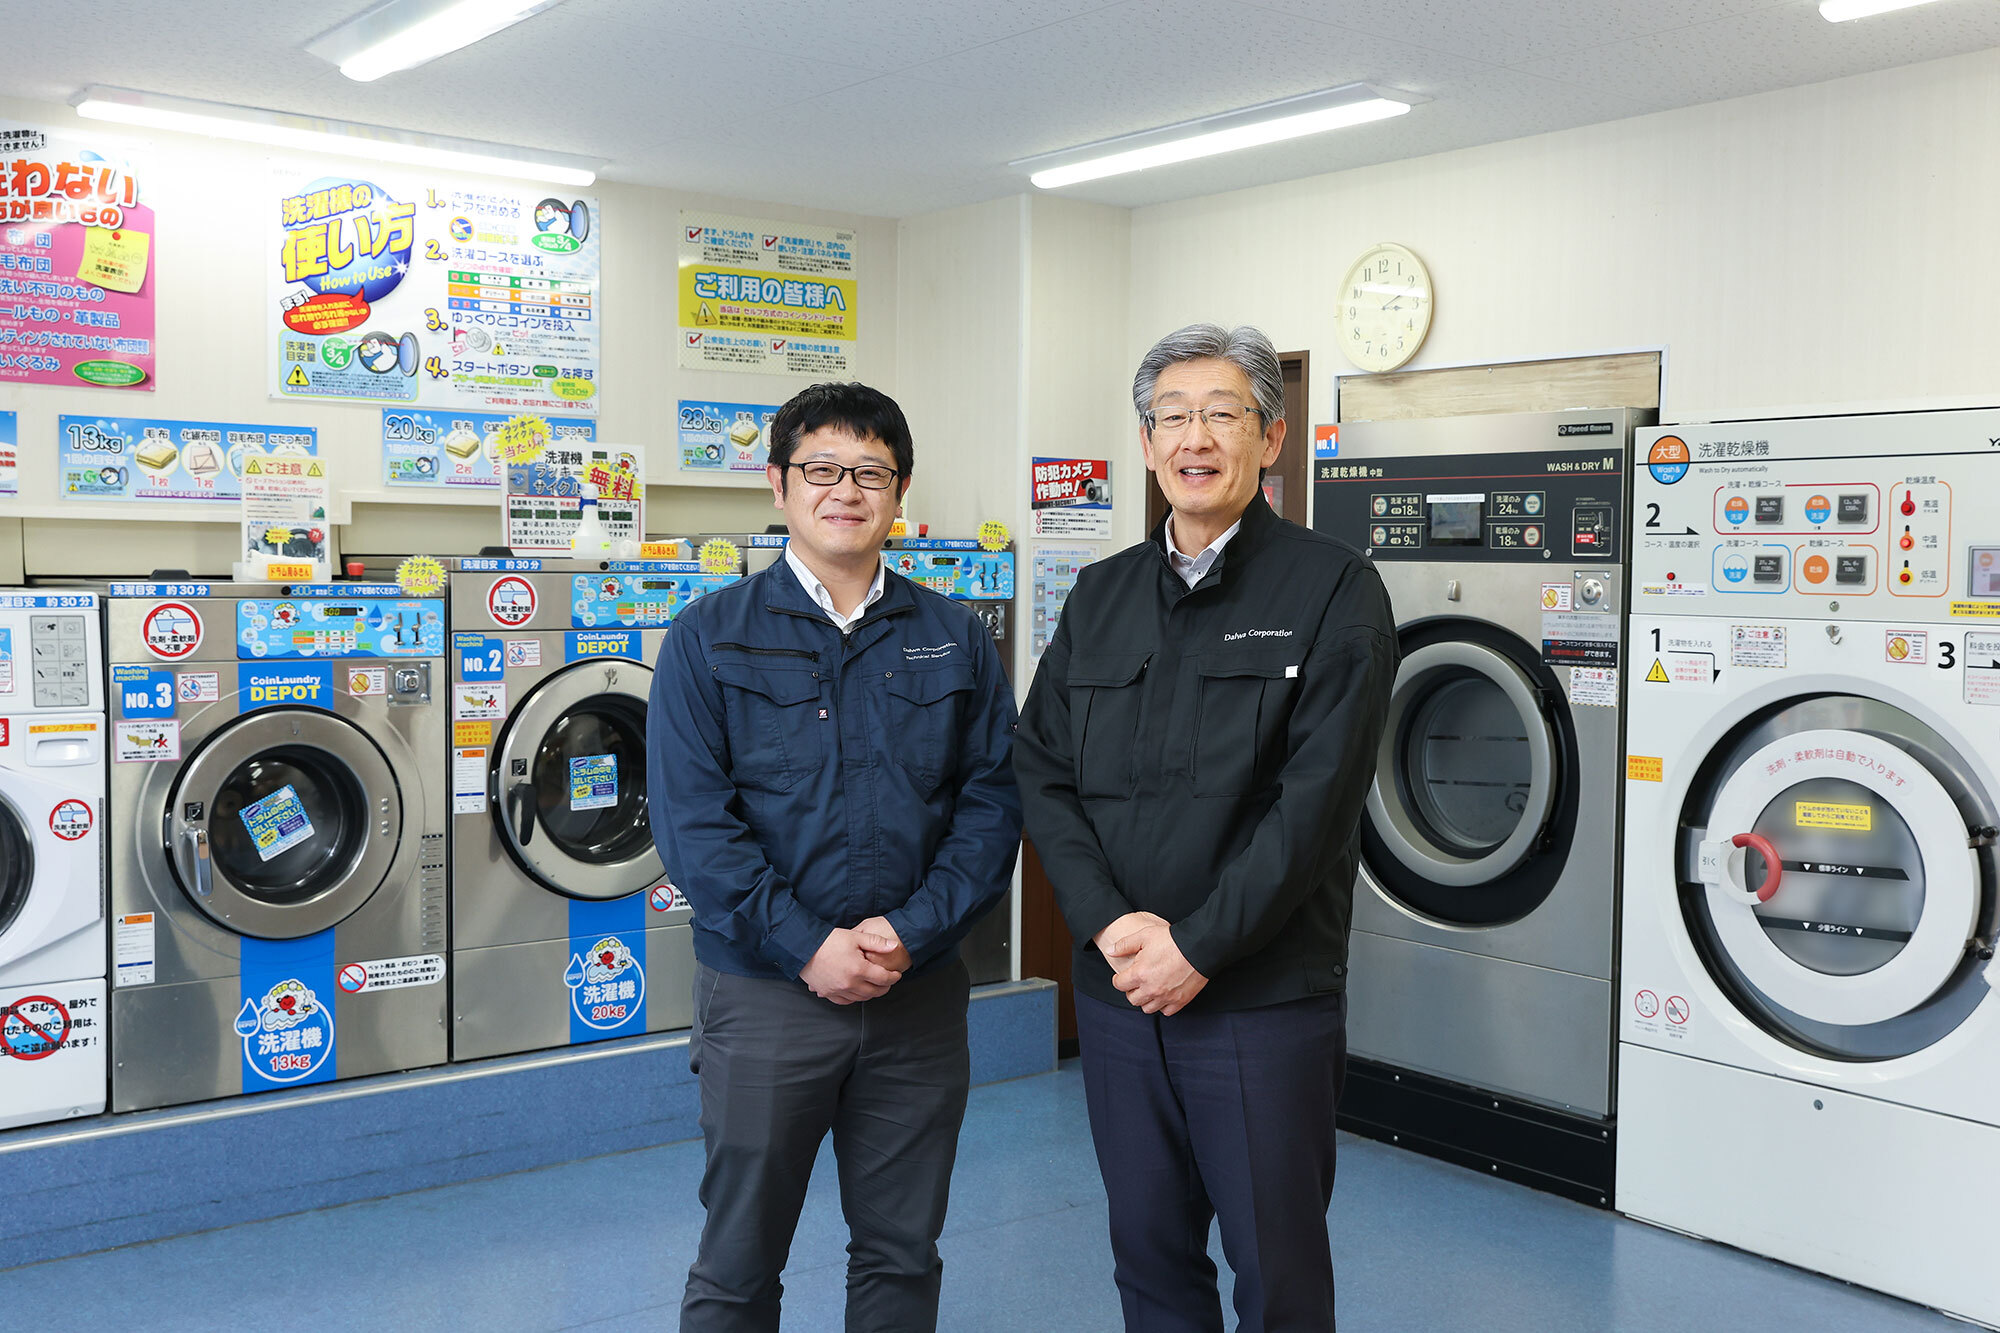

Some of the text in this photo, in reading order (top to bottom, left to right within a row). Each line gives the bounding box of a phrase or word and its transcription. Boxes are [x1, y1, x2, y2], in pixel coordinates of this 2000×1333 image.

[0, 159, 134, 204] わない
[427, 188, 446, 207] 1.
[282, 184, 372, 226] 洗濯機の
[281, 202, 415, 283] 使い方
[704, 237, 752, 248] ご確認ください
[425, 239, 544, 266] 2. 洗濯コースを選ぶ
[1378, 258, 1389, 274] 12
[1397, 261, 1401, 276] 1
[320, 265, 392, 291] How to Use
[1364, 268, 1372, 282] 11
[1407, 275, 1416, 288] 2
[695, 272, 846, 311] ご利用の皆様へ
[1353, 286, 1362, 299] 10
[280, 290, 310, 311] まず!
[1411, 296, 1420, 310] 3
[720, 306, 741, 314] 当店は
[1349, 306, 1357, 320] 9
[425, 308, 575, 332] 3. ゆっくりとコインを投入
[1406, 317, 1413, 331] 4
[1353, 327, 1361, 341] 8
[286, 341, 316, 352] 洗濯物
[1365, 340, 1372, 354] 7
[1396, 336, 1404, 350] 5
[1380, 344, 1388, 357] 6
[425, 356, 594, 380] 4. スタートボタン を押す
[453, 420, 473, 430] 毛布
[504, 419, 535, 434] ラッキー
[681, 407, 722, 434] 28kg
[145, 429, 169, 439] 毛布
[386, 416, 435, 444] 20kg
[505, 428, 536, 443] サイクル
[67, 424, 124, 454] 13kg
[1316, 433, 1336, 450] NO.1
[504, 438, 535, 459] 当たり
[1656, 440, 1769, 460] 大型 洗濯乾燥機
[545, 450, 583, 465] 洗濯機
[738, 451, 753, 461] 4枚
[265, 462, 302, 475] ご注意
[455, 464, 473, 475] 2枚
[535, 464, 584, 478] ラッキー
[1547, 457, 1614, 472] WASH & DRY M
[1720, 466, 1730, 475] Dry
[1731, 465, 1768, 473] automatically
[1034, 462, 1093, 483] 防犯カメラ
[1321, 466, 1383, 479] 洗濯乾燥機 中型
[1662, 473, 1674, 482] Dry
[148, 475, 214, 488] 1枚 1枚
[589, 466, 634, 502] 無料
[1905, 476, 1936, 485] 乾燥温度
[533, 481, 580, 495] サイクル
[1036, 479, 1080, 500] 作動中!
[1496, 495, 1521, 504] 洗濯のみ
[1923, 500, 1938, 508] 高温
[1402, 505, 1418, 515] 18kg
[1499, 504, 1518, 515] 24kg
[1645, 503, 1661, 527] 2
[753, 536, 783, 546] 洗濯目安
[1403, 535, 1415, 546] 9kg
[1499, 535, 1517, 546] 18kg
[1726, 539, 1759, 547] 洗濯コース
[1809, 539, 1845, 548] 乾燥コース
[1922, 535, 1937, 544] 中温
[462, 559, 540, 570] 洗濯目安 約30分
[1921, 570, 1937, 579] 低温
[113, 584, 208, 596] 洗濯目安 約30分
[46, 597, 90, 607] 約30分
[577, 633, 629, 642] CoinLaundry
[1224, 629, 1293, 641] Daiwa Corporation
[1650, 628, 1713, 652] 1 洗濯物を入れる
[1748, 630, 1769, 639] ご注意
[165, 643, 181, 652] 不要
[577, 641, 629, 654] DEPOT
[463, 649, 502, 672] NO.2
[1937, 641, 1956, 669] 3
[251, 675, 321, 686] CoinLaundry
[1584, 670, 1603, 680] ご注意
[125, 683, 172, 709] NO.3
[250, 685, 321, 701] DEPOT
[1766, 748, 1907, 788] 洗剤・柔軟剤は自動で入ります
[1702, 856, 1717, 867] 引く
[583, 981, 635, 1005] 洗濯機
[591, 1005, 626, 1021] 20kg
[258, 1026, 322, 1055] 洗濯機
[270, 1053, 311, 1072] 13kg
